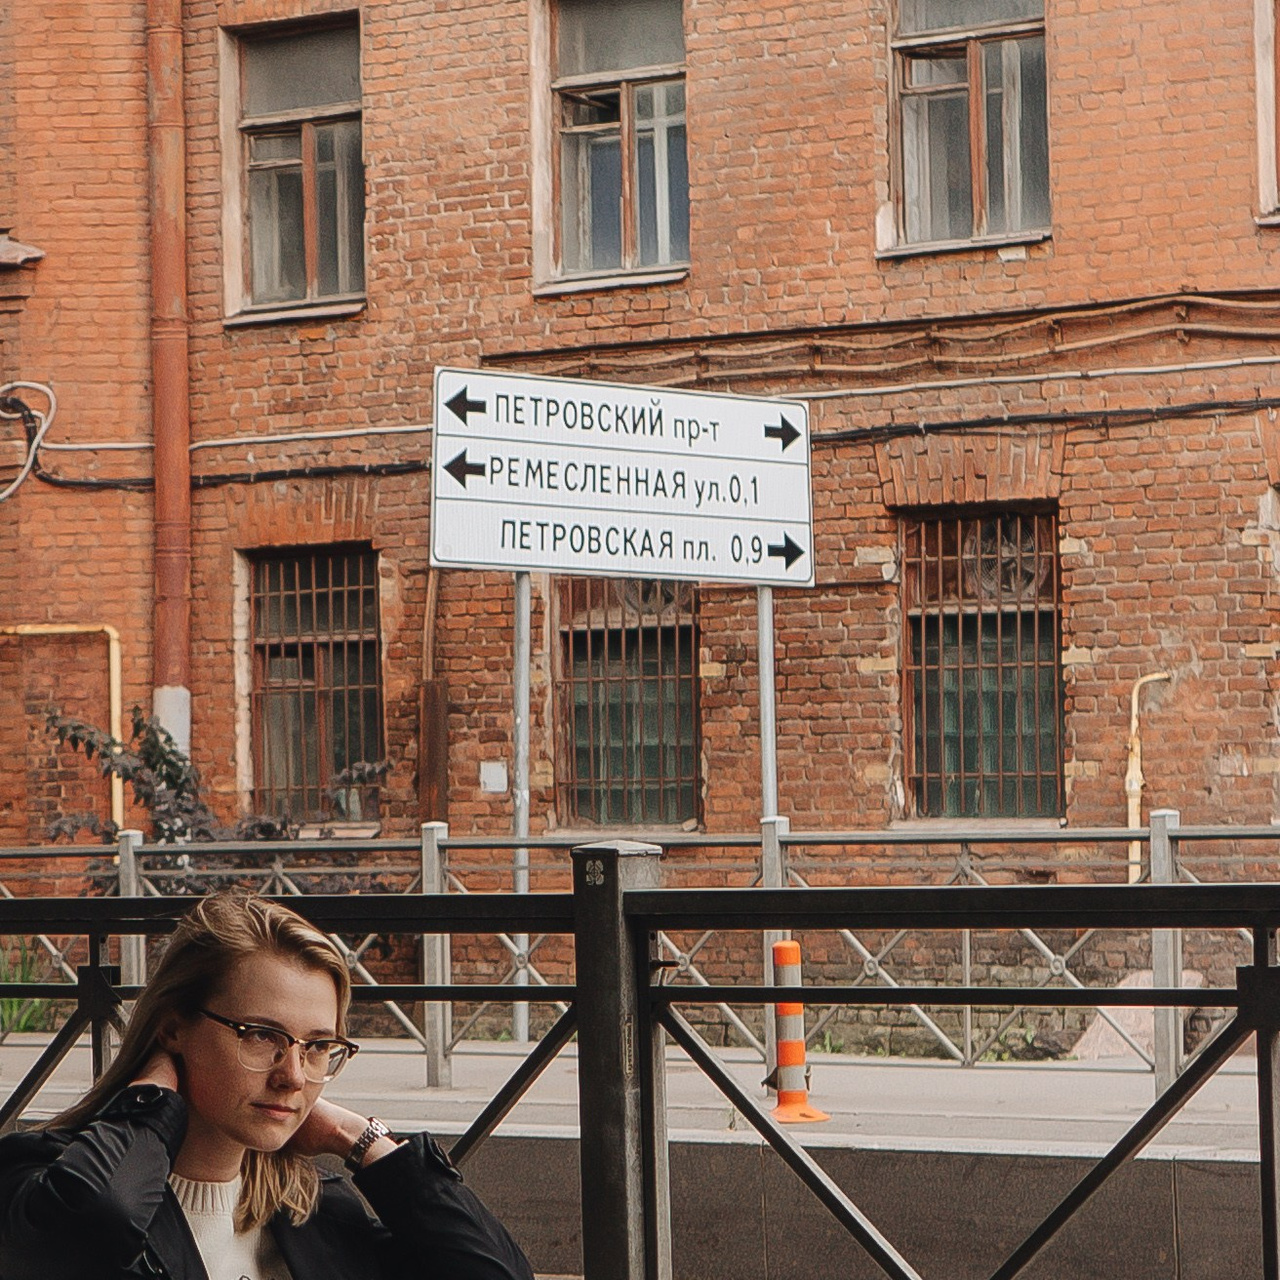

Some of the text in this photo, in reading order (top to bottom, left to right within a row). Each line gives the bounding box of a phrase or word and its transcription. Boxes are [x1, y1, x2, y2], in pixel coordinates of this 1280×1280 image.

[495, 393, 720, 447] ПЕТРОВСКИЙ пр-т
[490, 455, 686, 499] РЕМЕСЛЕННАЯ
[501, 519, 763, 567] ПЕТРОВСКАЯ пл. 0,9
